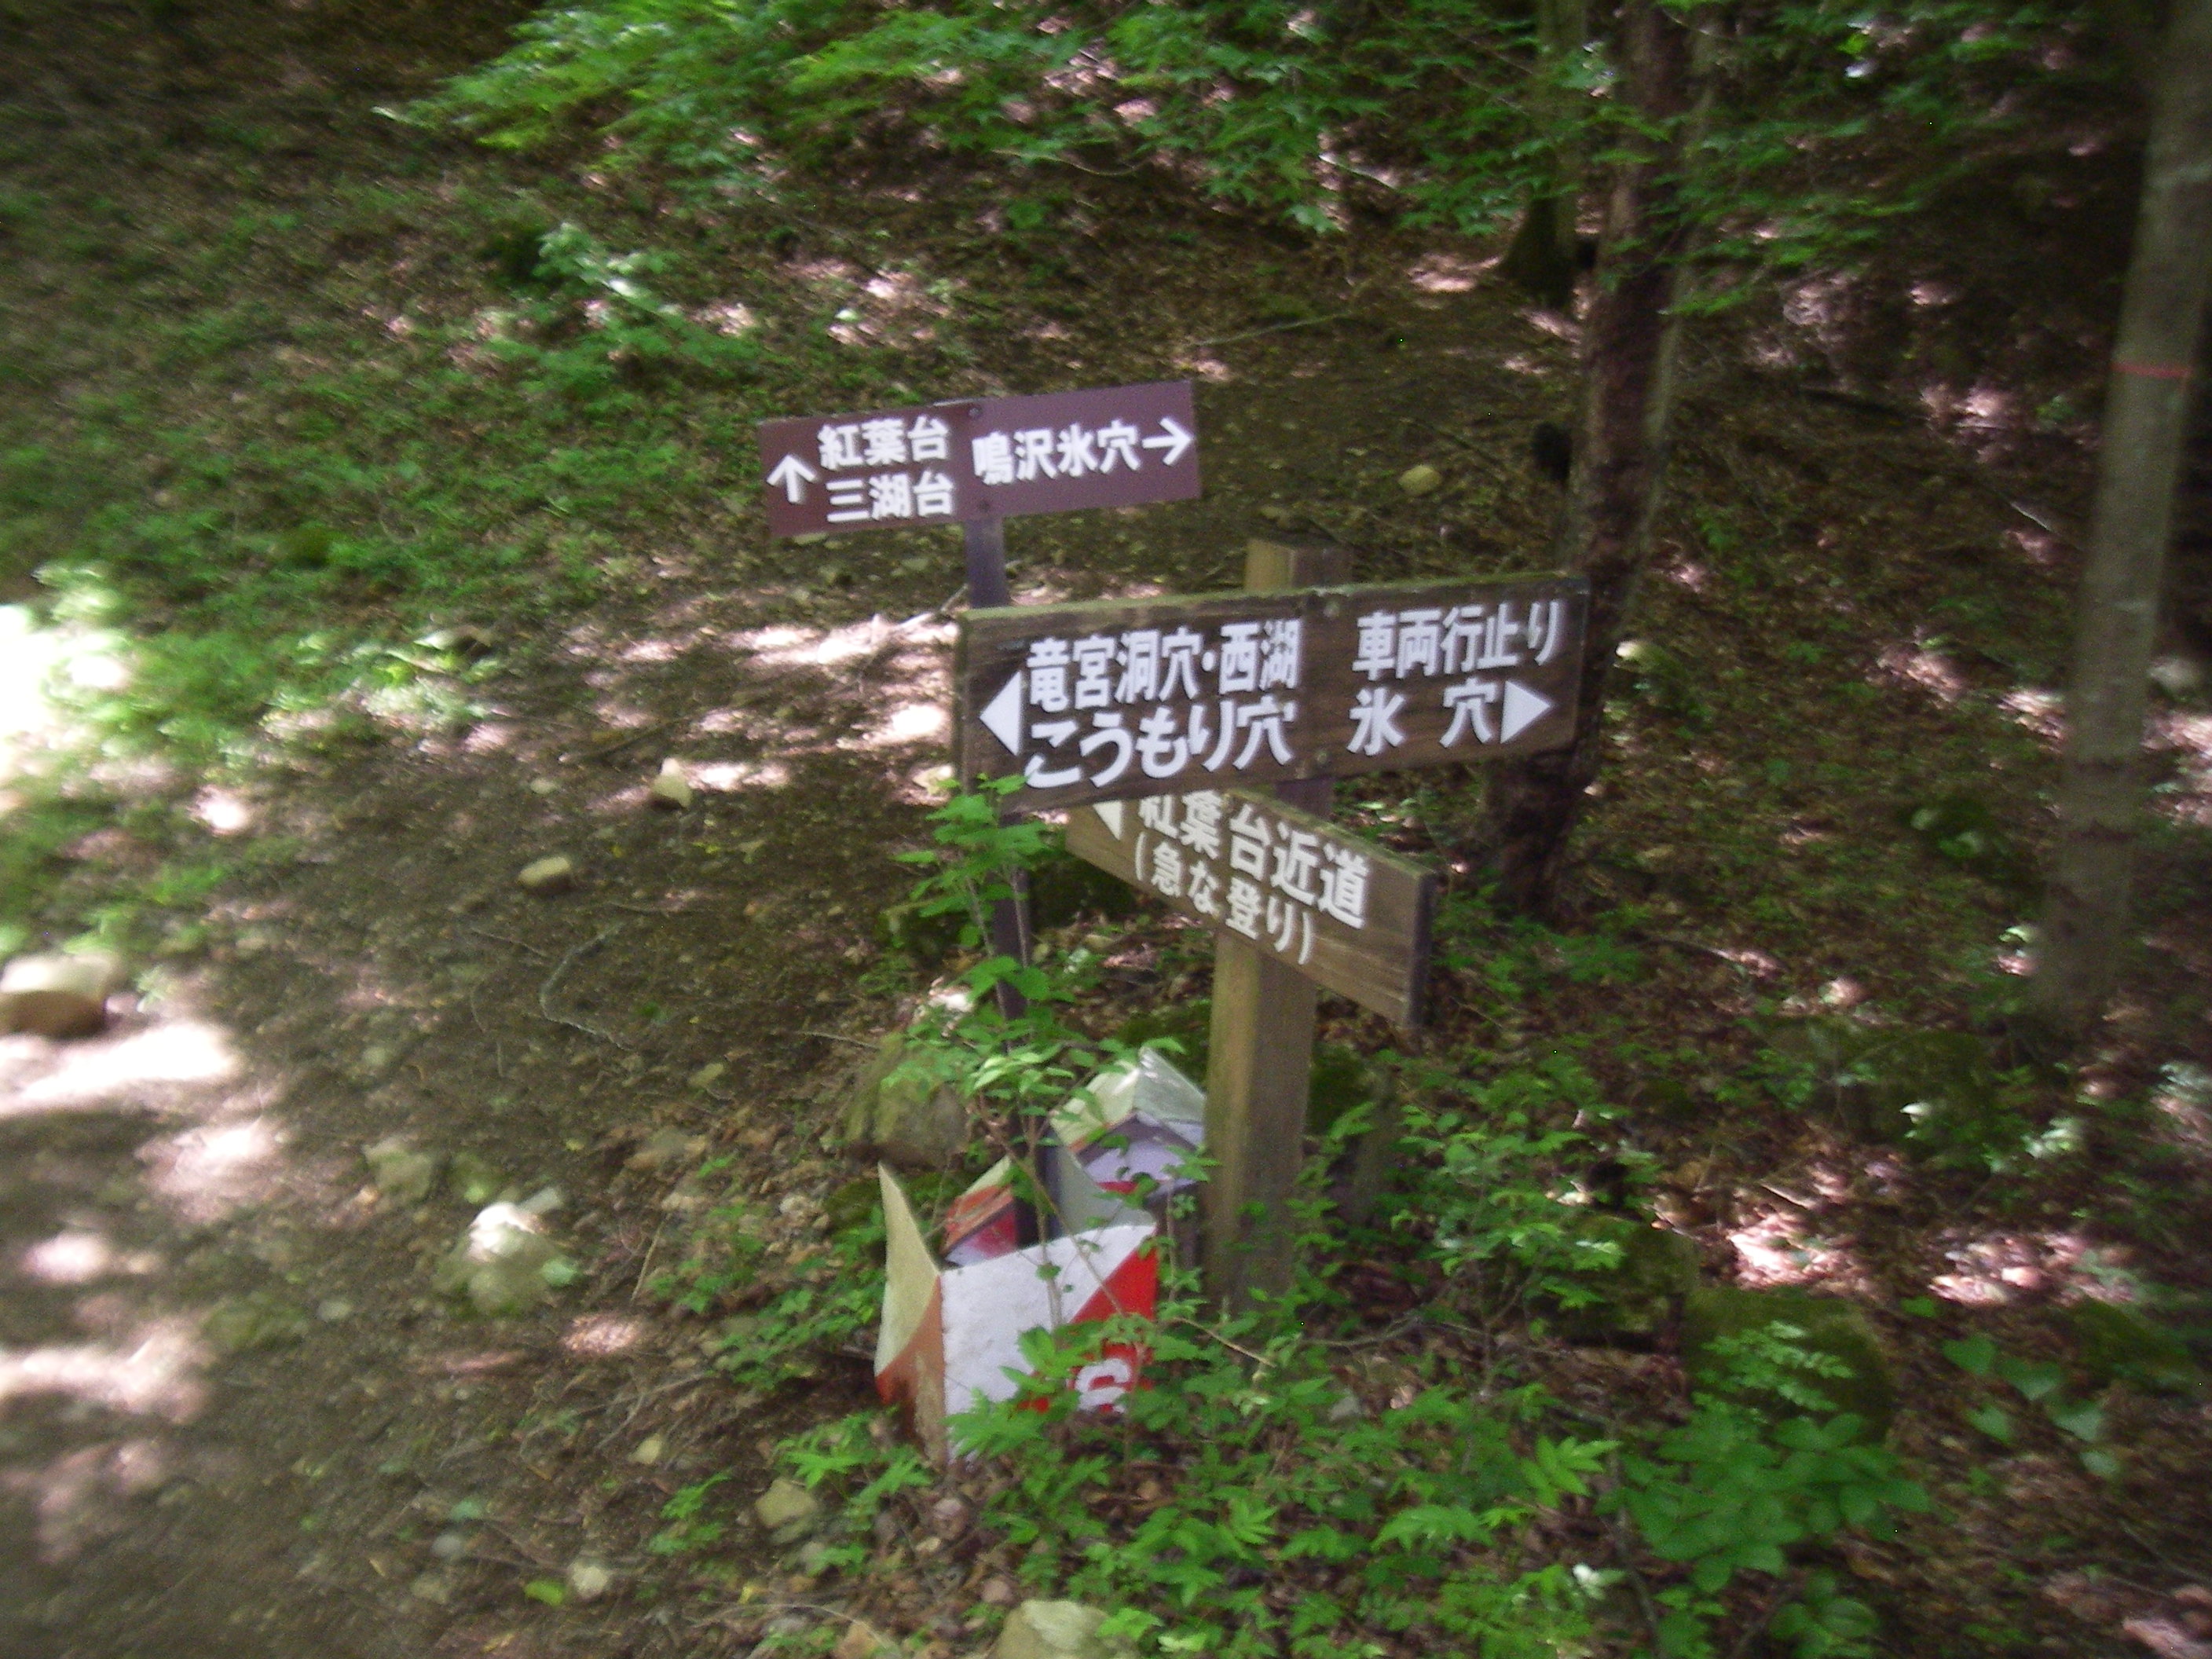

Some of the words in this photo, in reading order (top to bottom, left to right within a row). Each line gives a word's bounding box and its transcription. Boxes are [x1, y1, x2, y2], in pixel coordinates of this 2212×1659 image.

[819, 416, 950, 470] 紅葉台
[972, 419, 1141, 485] 鳴沢氷穴
[826, 471, 954, 523] 三湖台
[1353, 601, 1562, 681] 車両行止り
[1026, 698, 1295, 786] こうもり穴
